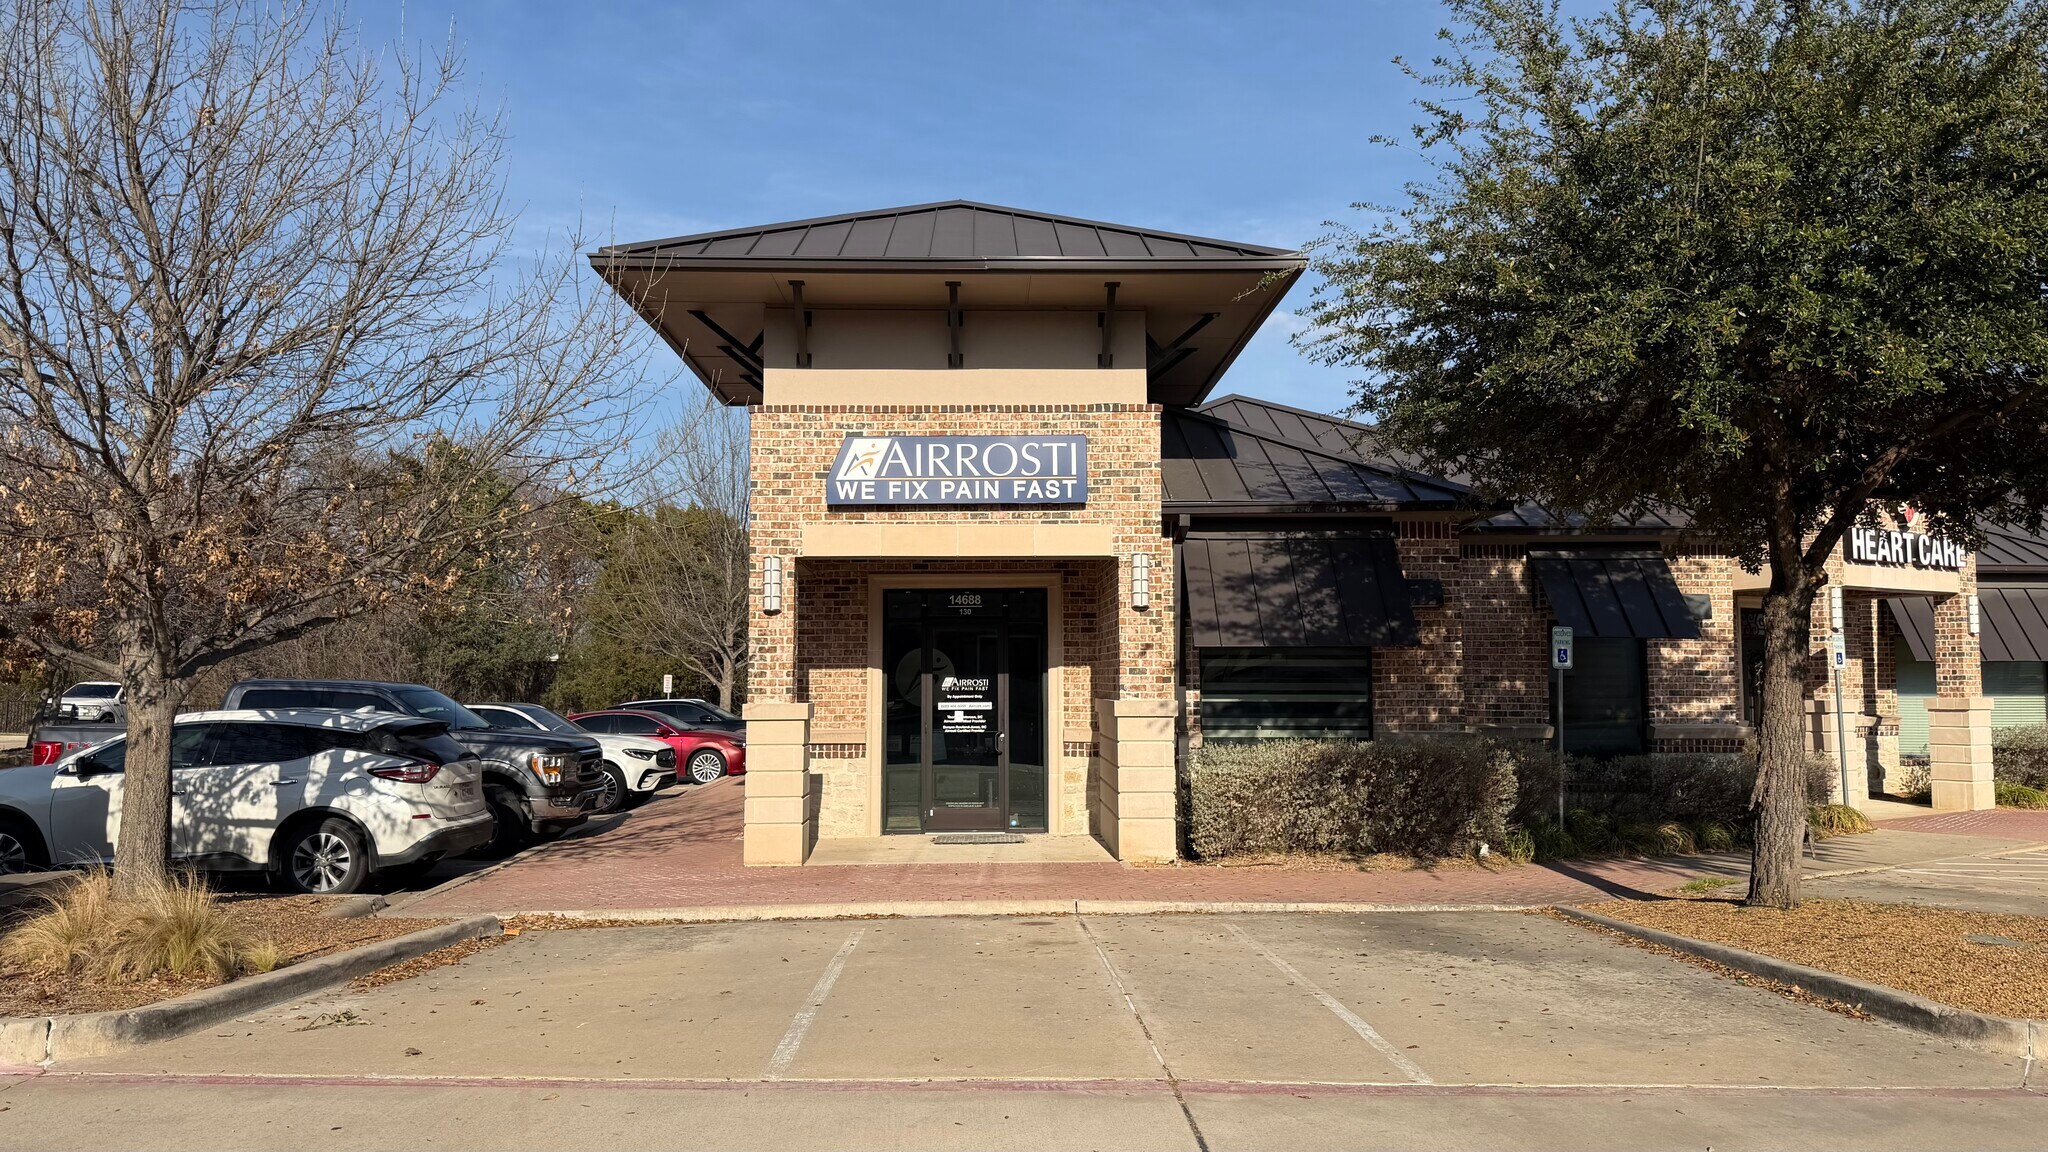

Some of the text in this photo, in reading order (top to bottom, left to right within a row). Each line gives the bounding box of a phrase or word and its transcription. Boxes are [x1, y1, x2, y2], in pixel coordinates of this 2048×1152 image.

[880, 440, 1077, 477] AIRROSTI
[836, 479, 1077, 500] WE FIX PAIN FAST
[1851, 527, 1967, 568] HEART CARE
[949, 595, 981, 605] 14688
[959, 608, 972, 616] 130
[951, 677, 988, 686] AIRROSTI
[66, 741, 95, 751] FX
